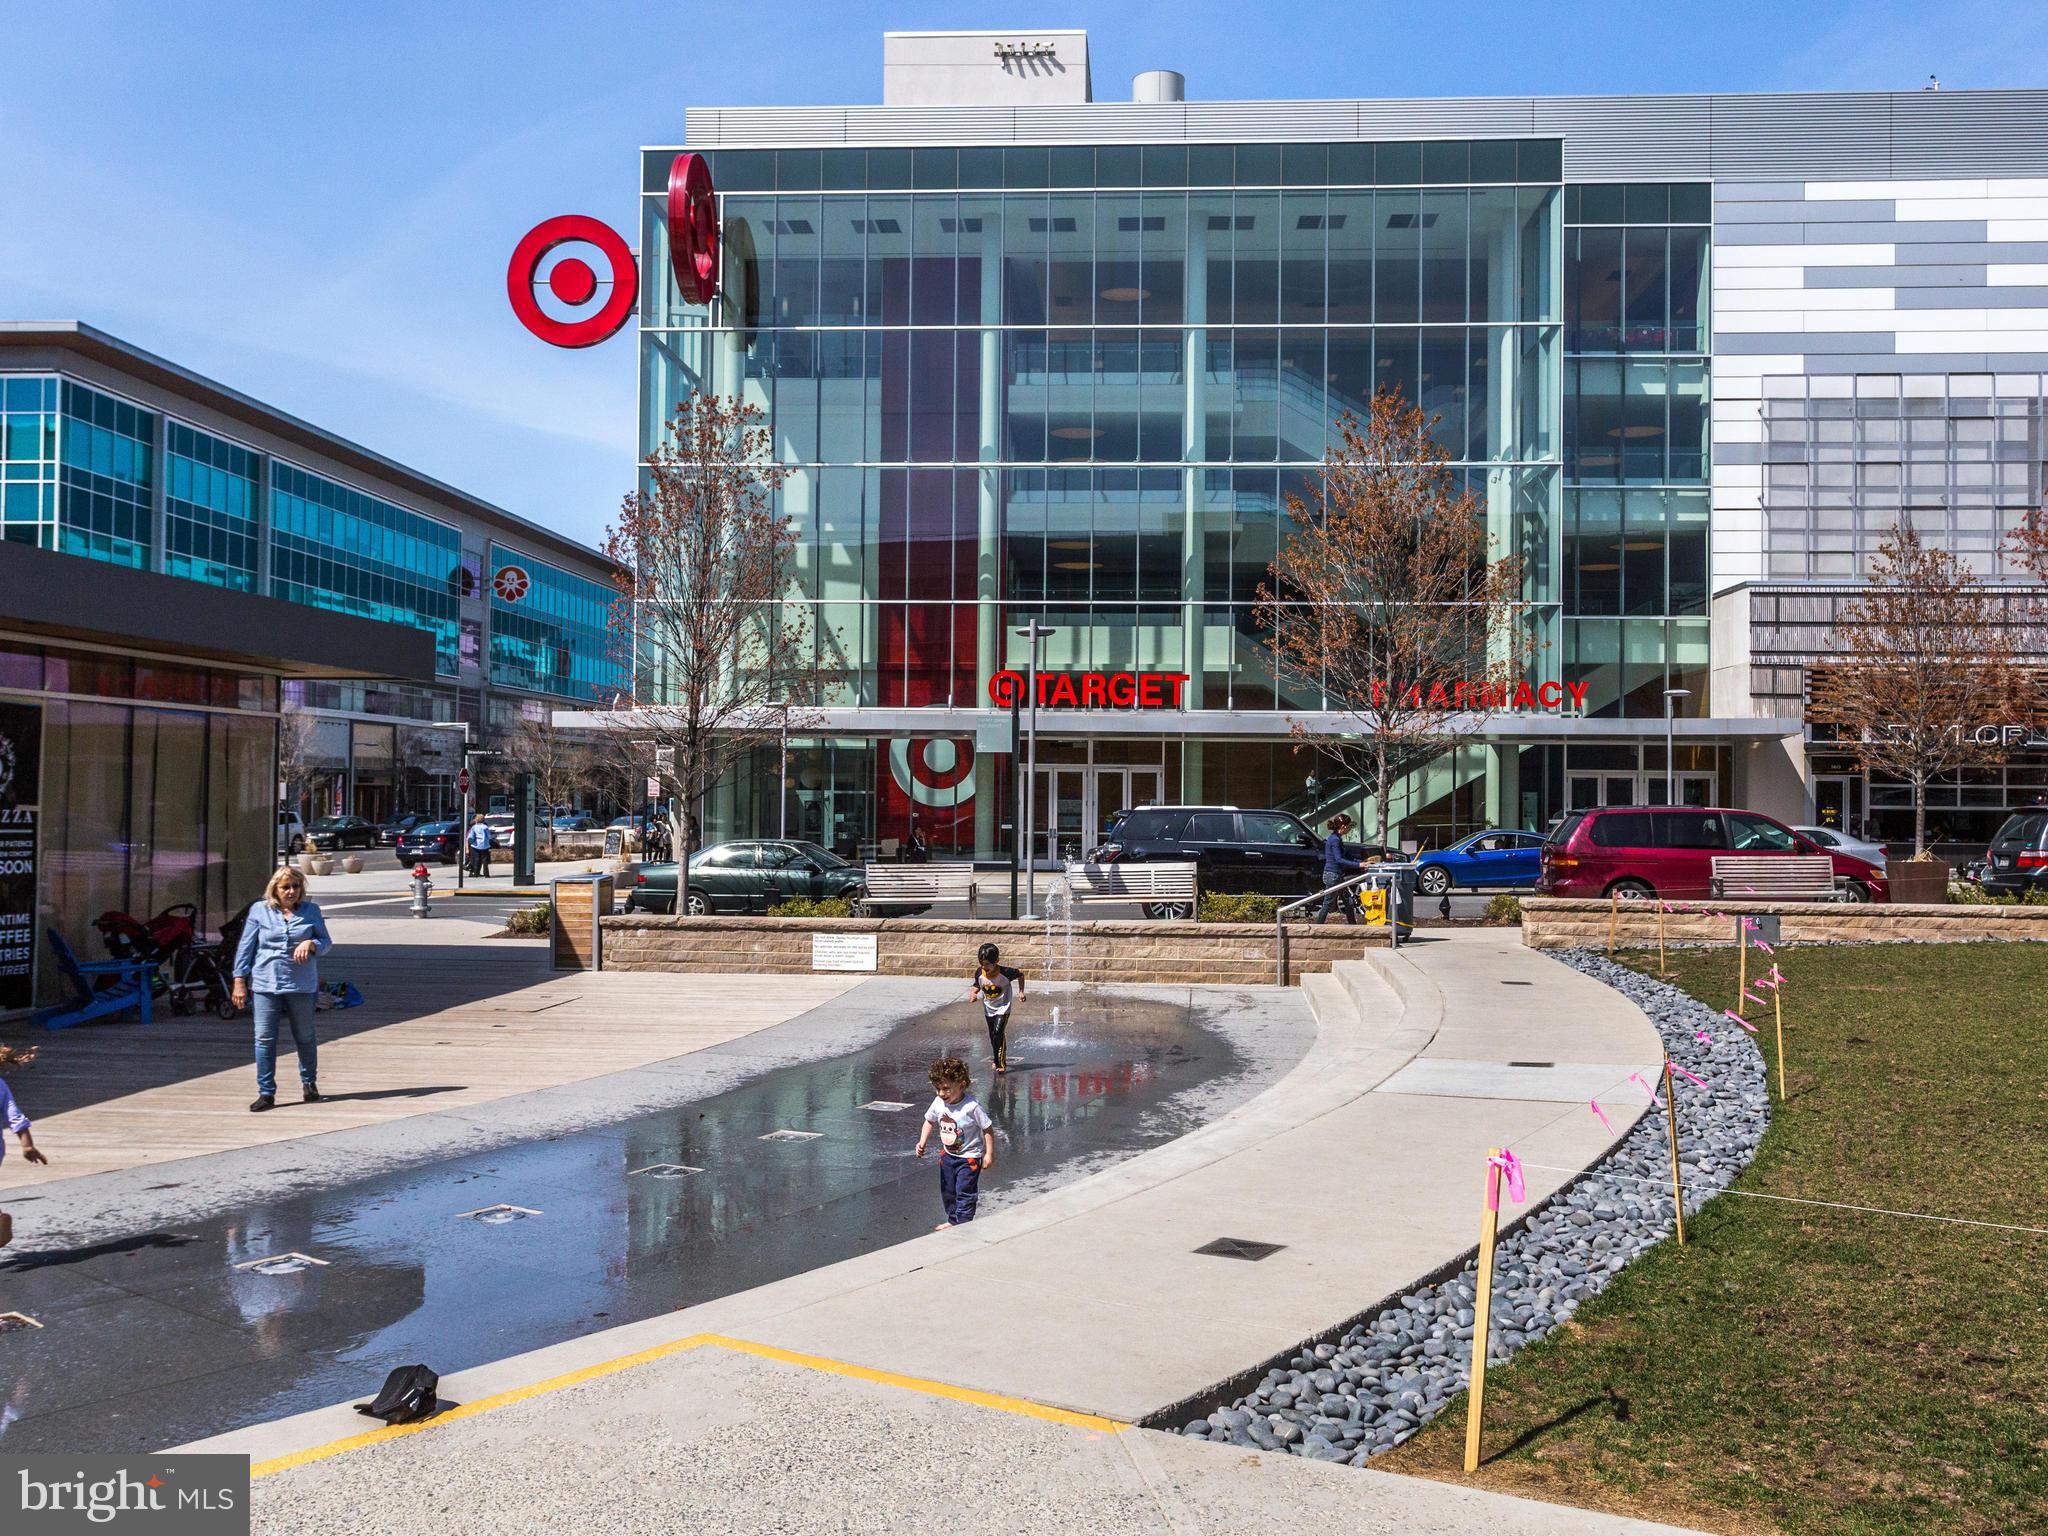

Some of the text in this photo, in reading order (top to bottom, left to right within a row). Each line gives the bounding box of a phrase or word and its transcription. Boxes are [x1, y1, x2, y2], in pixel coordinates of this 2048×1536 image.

[1035, 672, 1190, 705] TARGET
[1371, 680, 1590, 708] PHARMACY
[1888, 724, 2027, 746] TLOR
[0, 860, 33, 874] SOON
[0, 929, 31, 944] FFEE
[0, 963, 31, 977] TREET
